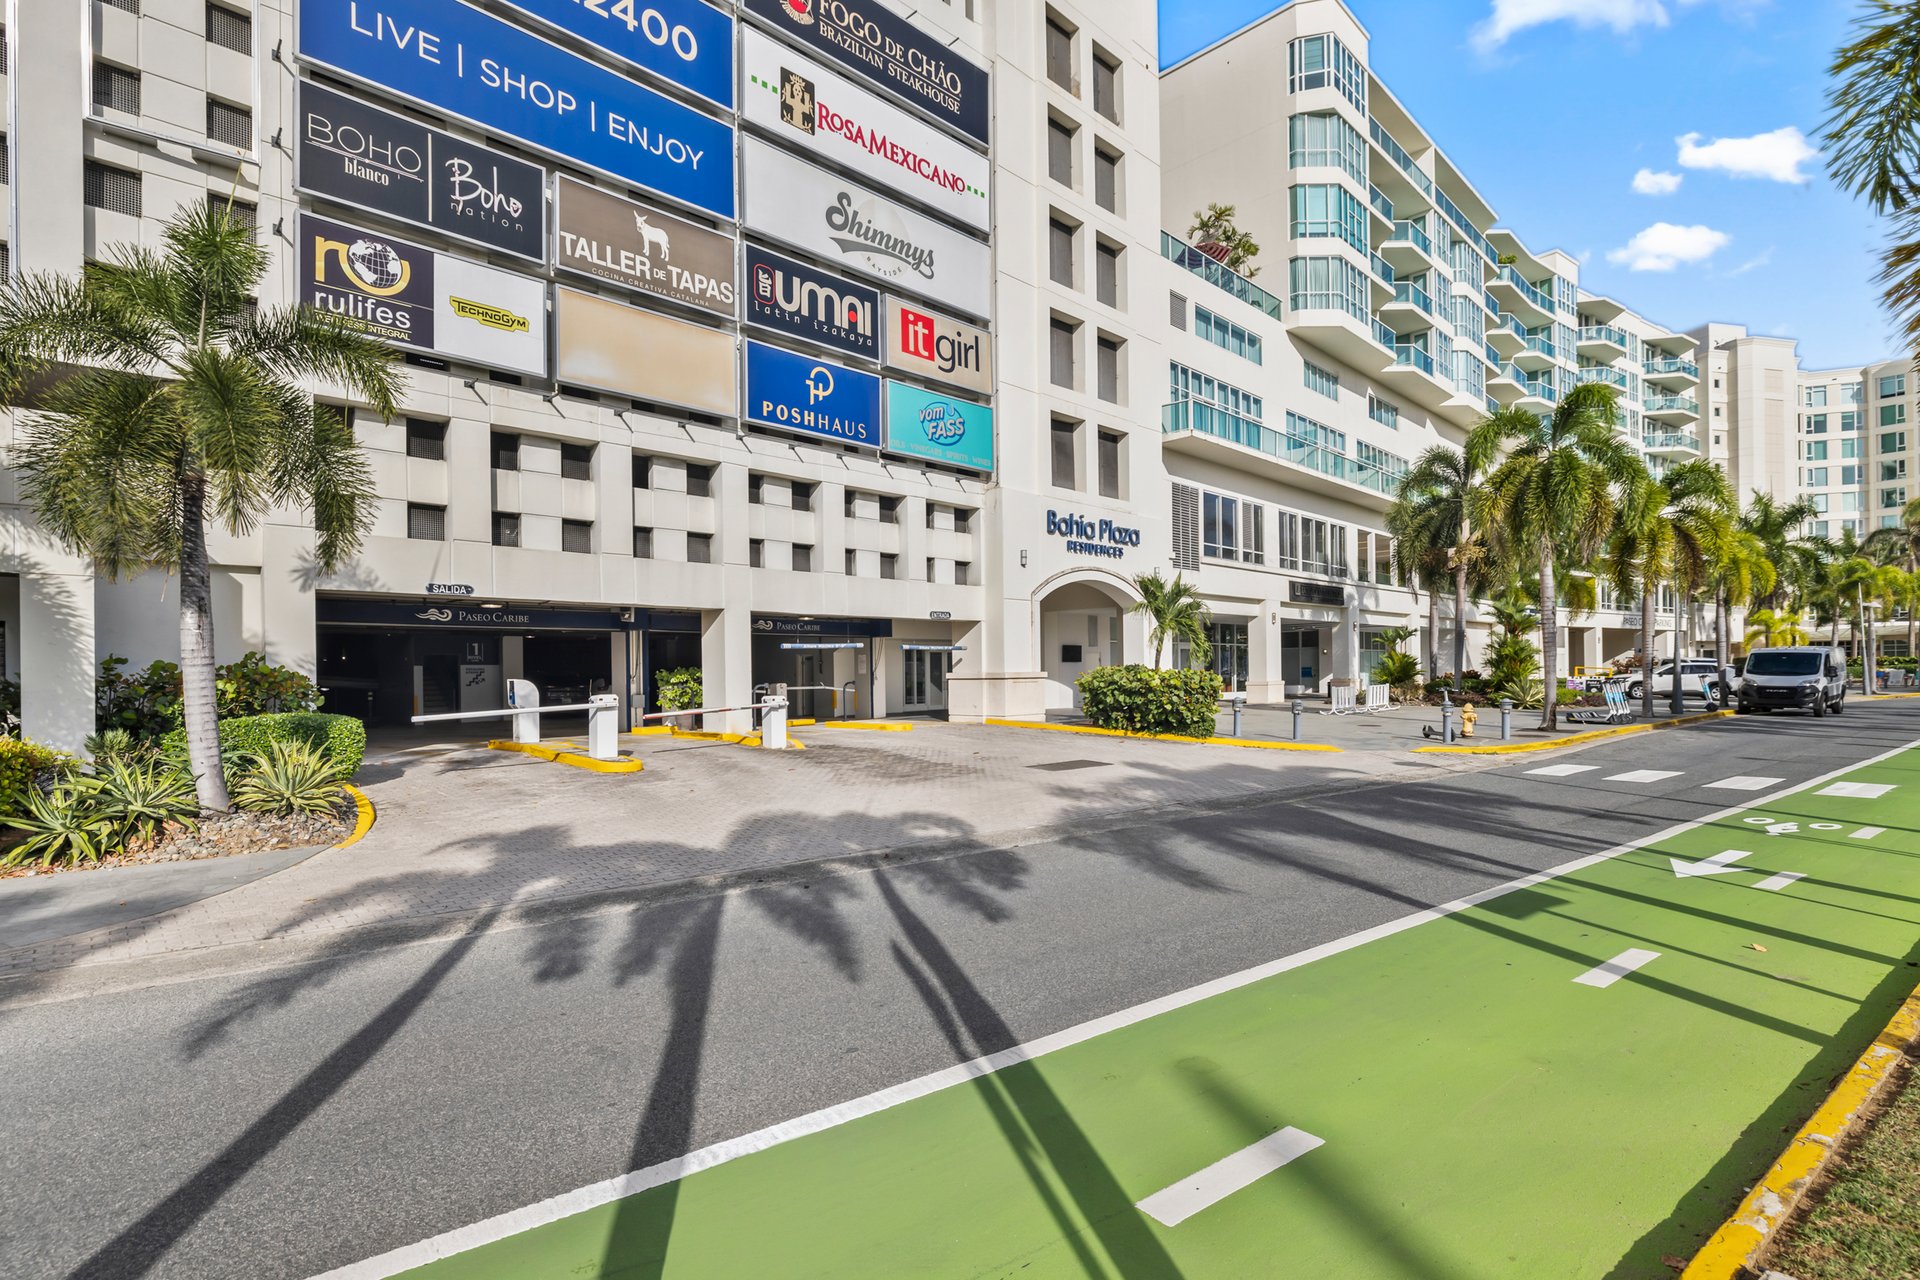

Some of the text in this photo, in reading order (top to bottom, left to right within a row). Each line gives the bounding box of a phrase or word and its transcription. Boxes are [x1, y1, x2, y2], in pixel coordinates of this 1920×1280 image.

[819, 0, 882, 47] FOGO
[885, 37, 905, 62] DE
[350, 2, 704, 171] LIVE SHOP ENJOY
[819, 21, 961, 115] BRAZILIAN STEAKHOUSE
[308, 113, 422, 172] BOHO
[816, 101, 966, 193] ROSA MEXICANO
[344, 156, 389, 187] blanco
[445, 157, 523, 219] Boho
[450, 201, 523, 232] nation
[825, 191, 935, 280] Shimmys
[560, 231, 735, 304] TALLER DE TAPAS
[591, 267, 710, 306] COCINA CREATIVA CATALANA
[315, 291, 411, 329] rulifes
[754, 300, 872, 346] latin izakaya
[367, 325, 411, 341] INTEGRAL
[908, 313, 980, 373] it girl
[762, 400, 867, 439] POSHHAUS
[919, 406, 944, 424] vom
[927, 417, 966, 441] FASS
[1066, 540, 1125, 560] RESIDENCES
[1099, 518, 1141, 548] Plaza
[432, 584, 467, 595] SALIDA
[471, 642, 480, 656] 1
